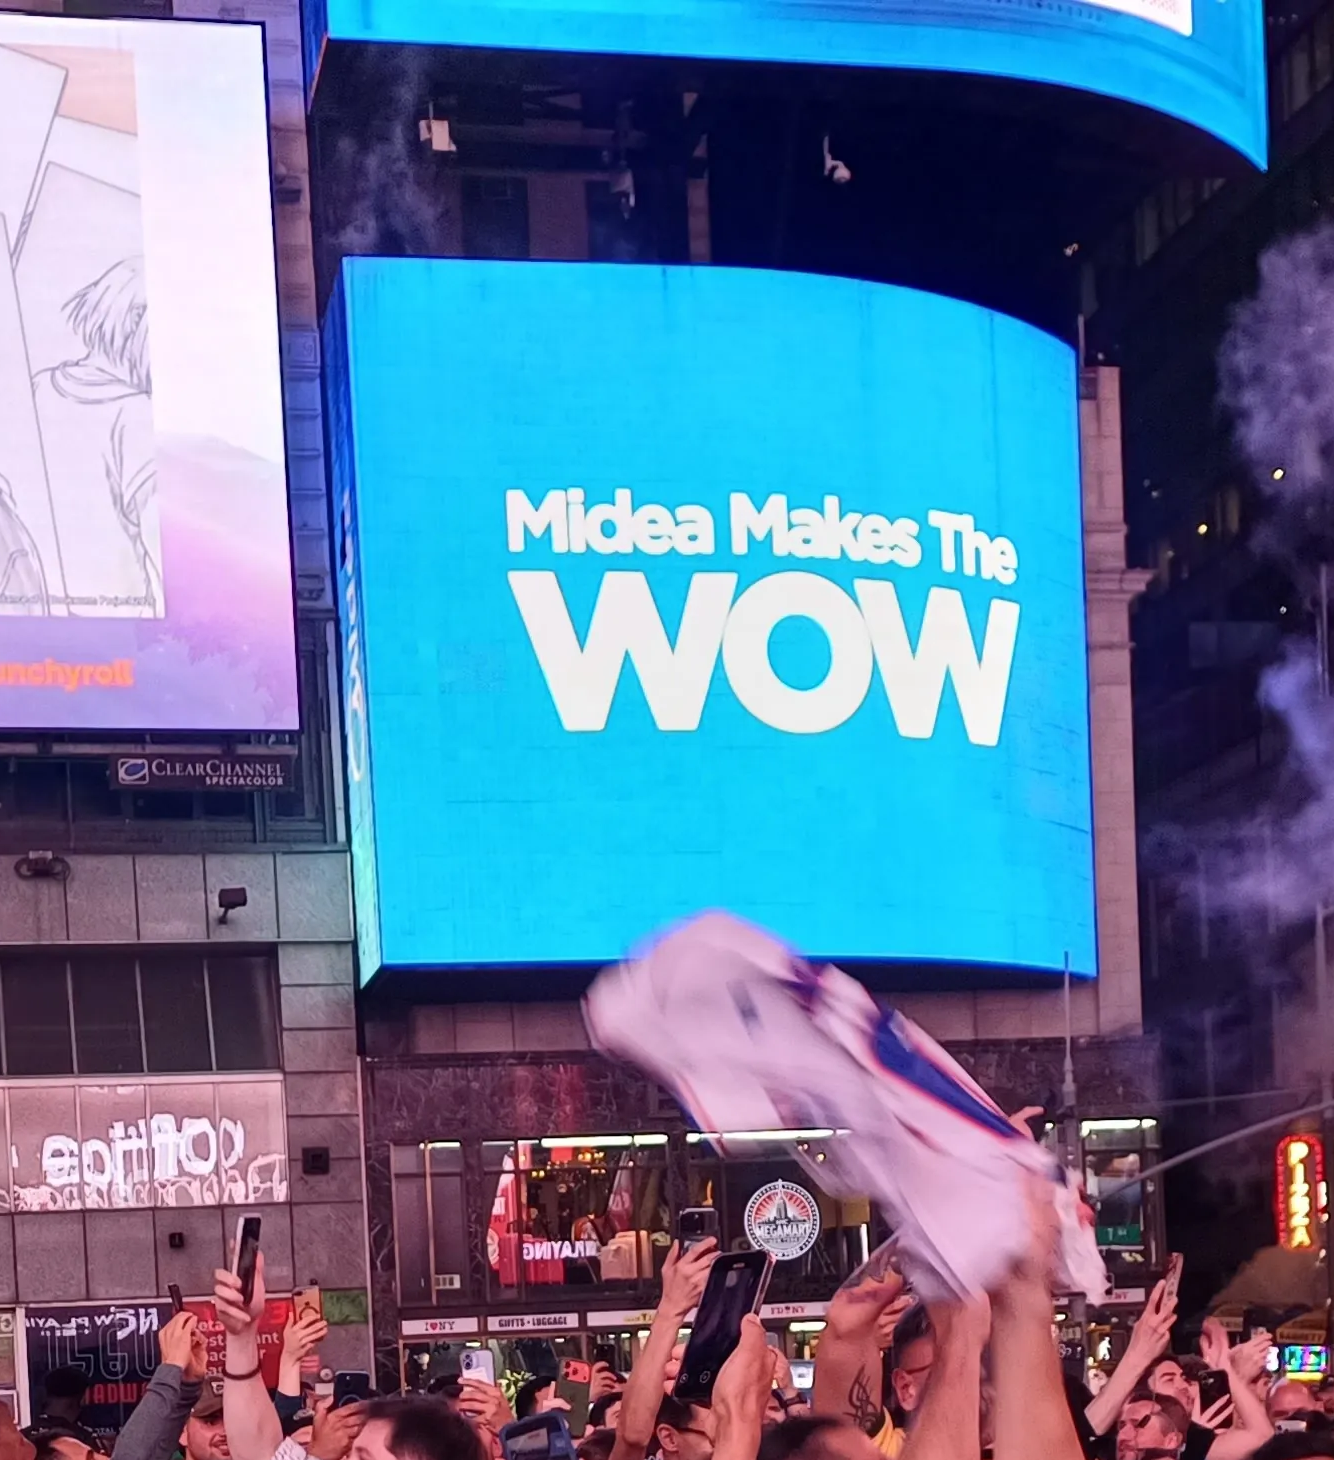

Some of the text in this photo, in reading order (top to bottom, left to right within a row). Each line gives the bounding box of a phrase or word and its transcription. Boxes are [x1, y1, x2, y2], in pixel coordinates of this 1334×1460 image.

[505, 487, 1019, 585] Midea Makes The
[506, 569, 1021, 748] WOW
[1287, 1141, 1312, 1248] PIZZA
[438, 1321, 455, 1331] NY
[498, 1316, 568, 1328] GIFTS LUGGAGE
